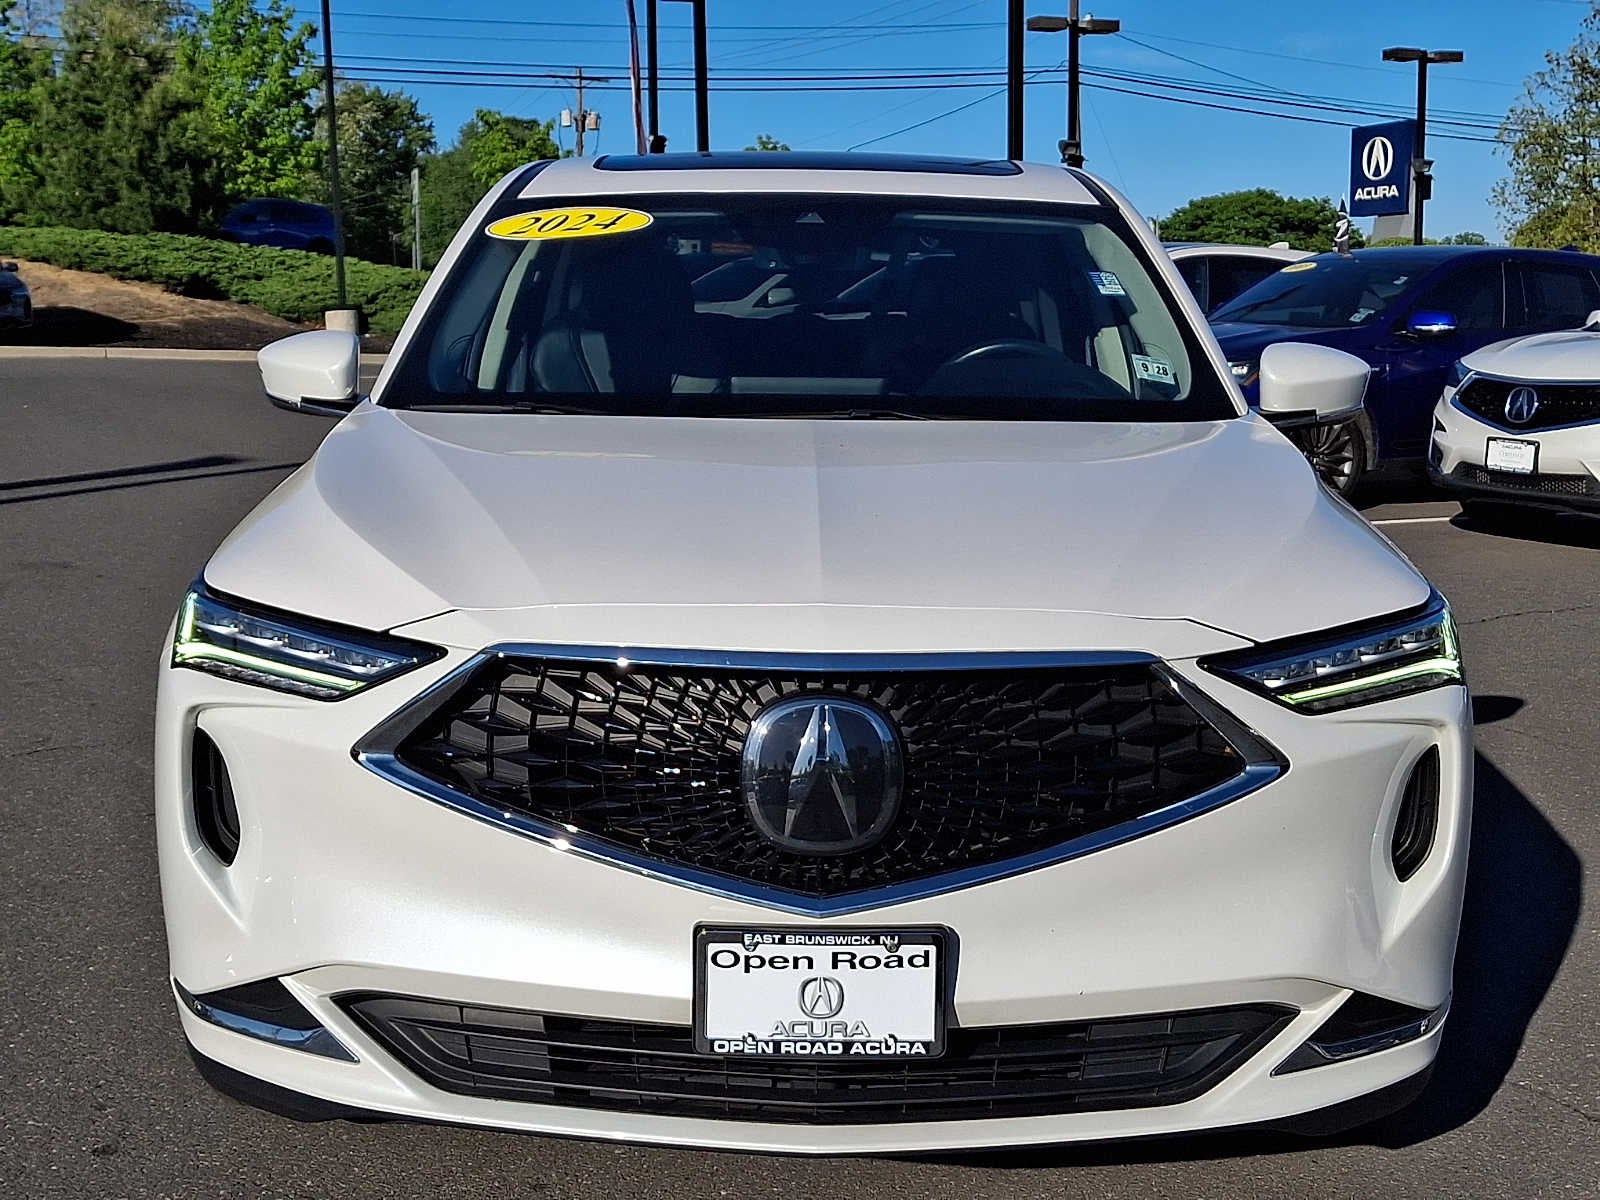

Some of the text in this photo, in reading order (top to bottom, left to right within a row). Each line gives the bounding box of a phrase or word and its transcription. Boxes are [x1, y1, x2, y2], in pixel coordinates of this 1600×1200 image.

[1353, 184, 1399, 201] ACURA
[506, 212, 630, 236] 2024
[1141, 362, 1169, 377] 9 28
[743, 933, 899, 946] EAST BRUNSWICK, NJ
[710, 949, 930, 974] Open Road
[768, 1020, 871, 1038] ACURA
[713, 1040, 927, 1055] OPEN ROAD ACURA
